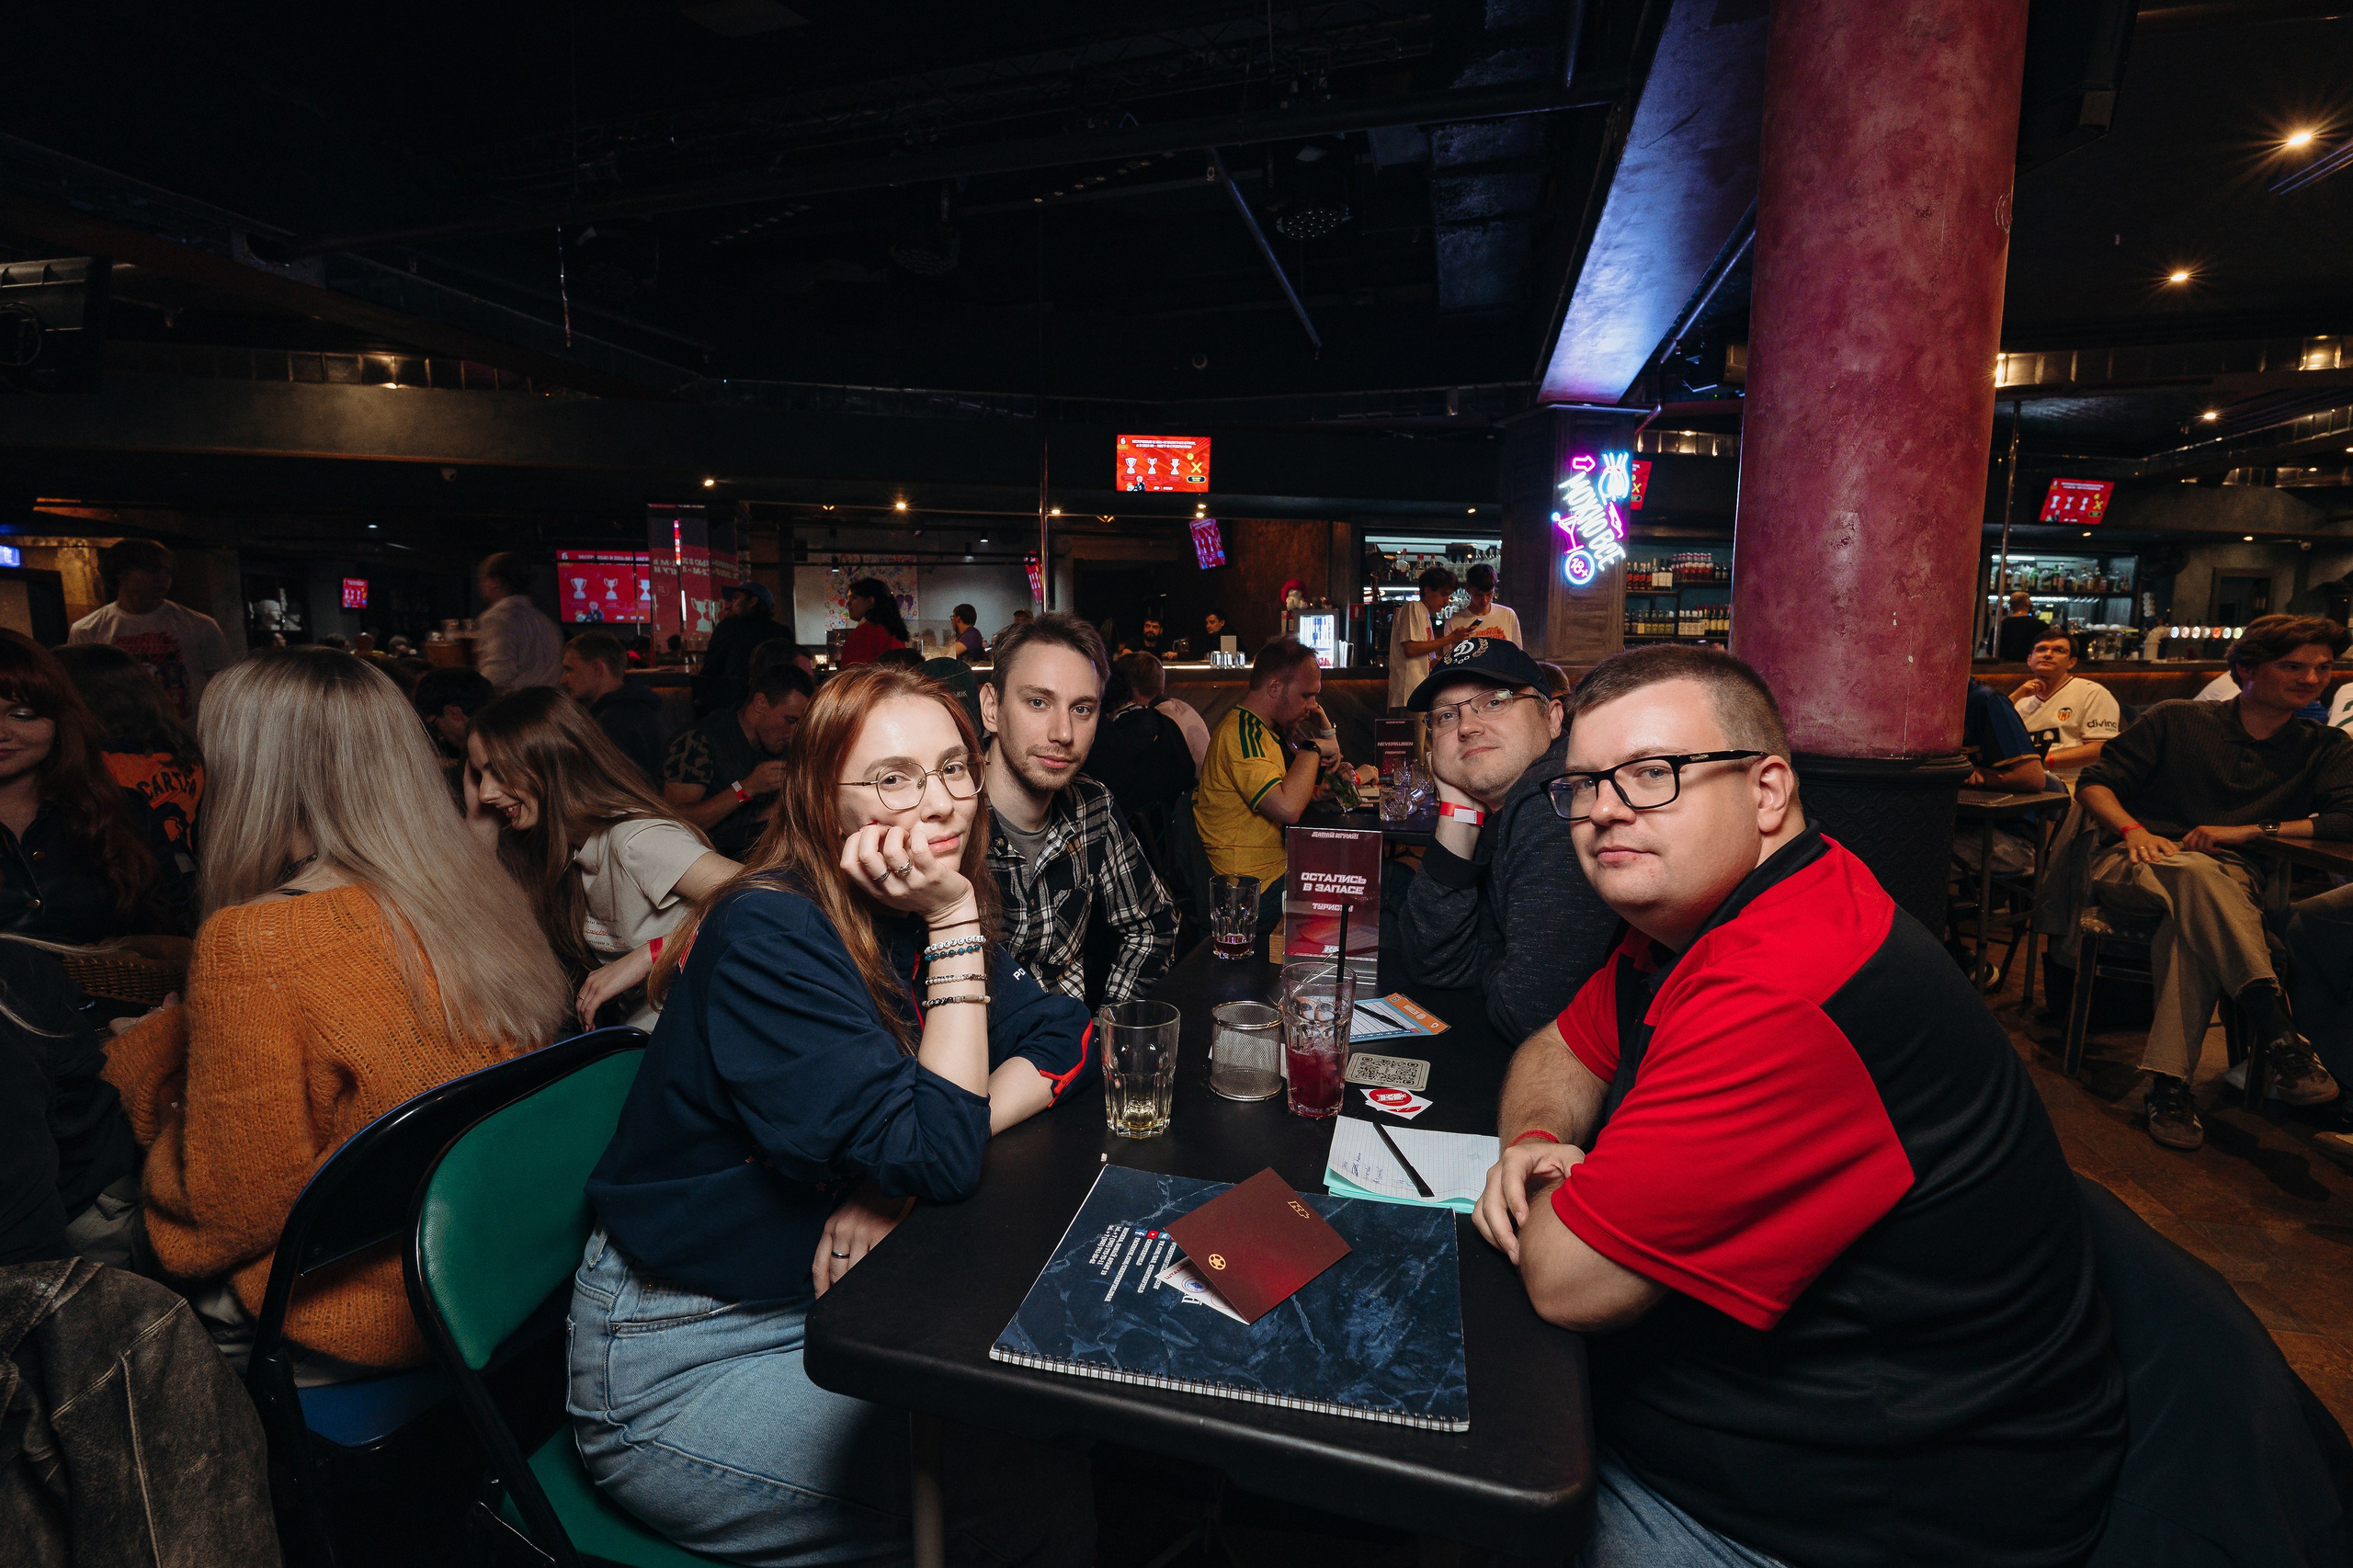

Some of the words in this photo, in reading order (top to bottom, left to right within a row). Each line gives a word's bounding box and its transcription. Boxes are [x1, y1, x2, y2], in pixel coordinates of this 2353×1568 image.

[1558, 471, 1608, 538] МОЖНО
[1571, 557, 1588, 577] 18+
[1301, 871, 1368, 885] ОСТАЛИСЬ
[1302, 882, 1313, 892] В
[1314, 883, 1365, 895] ЗАПАСЕ
